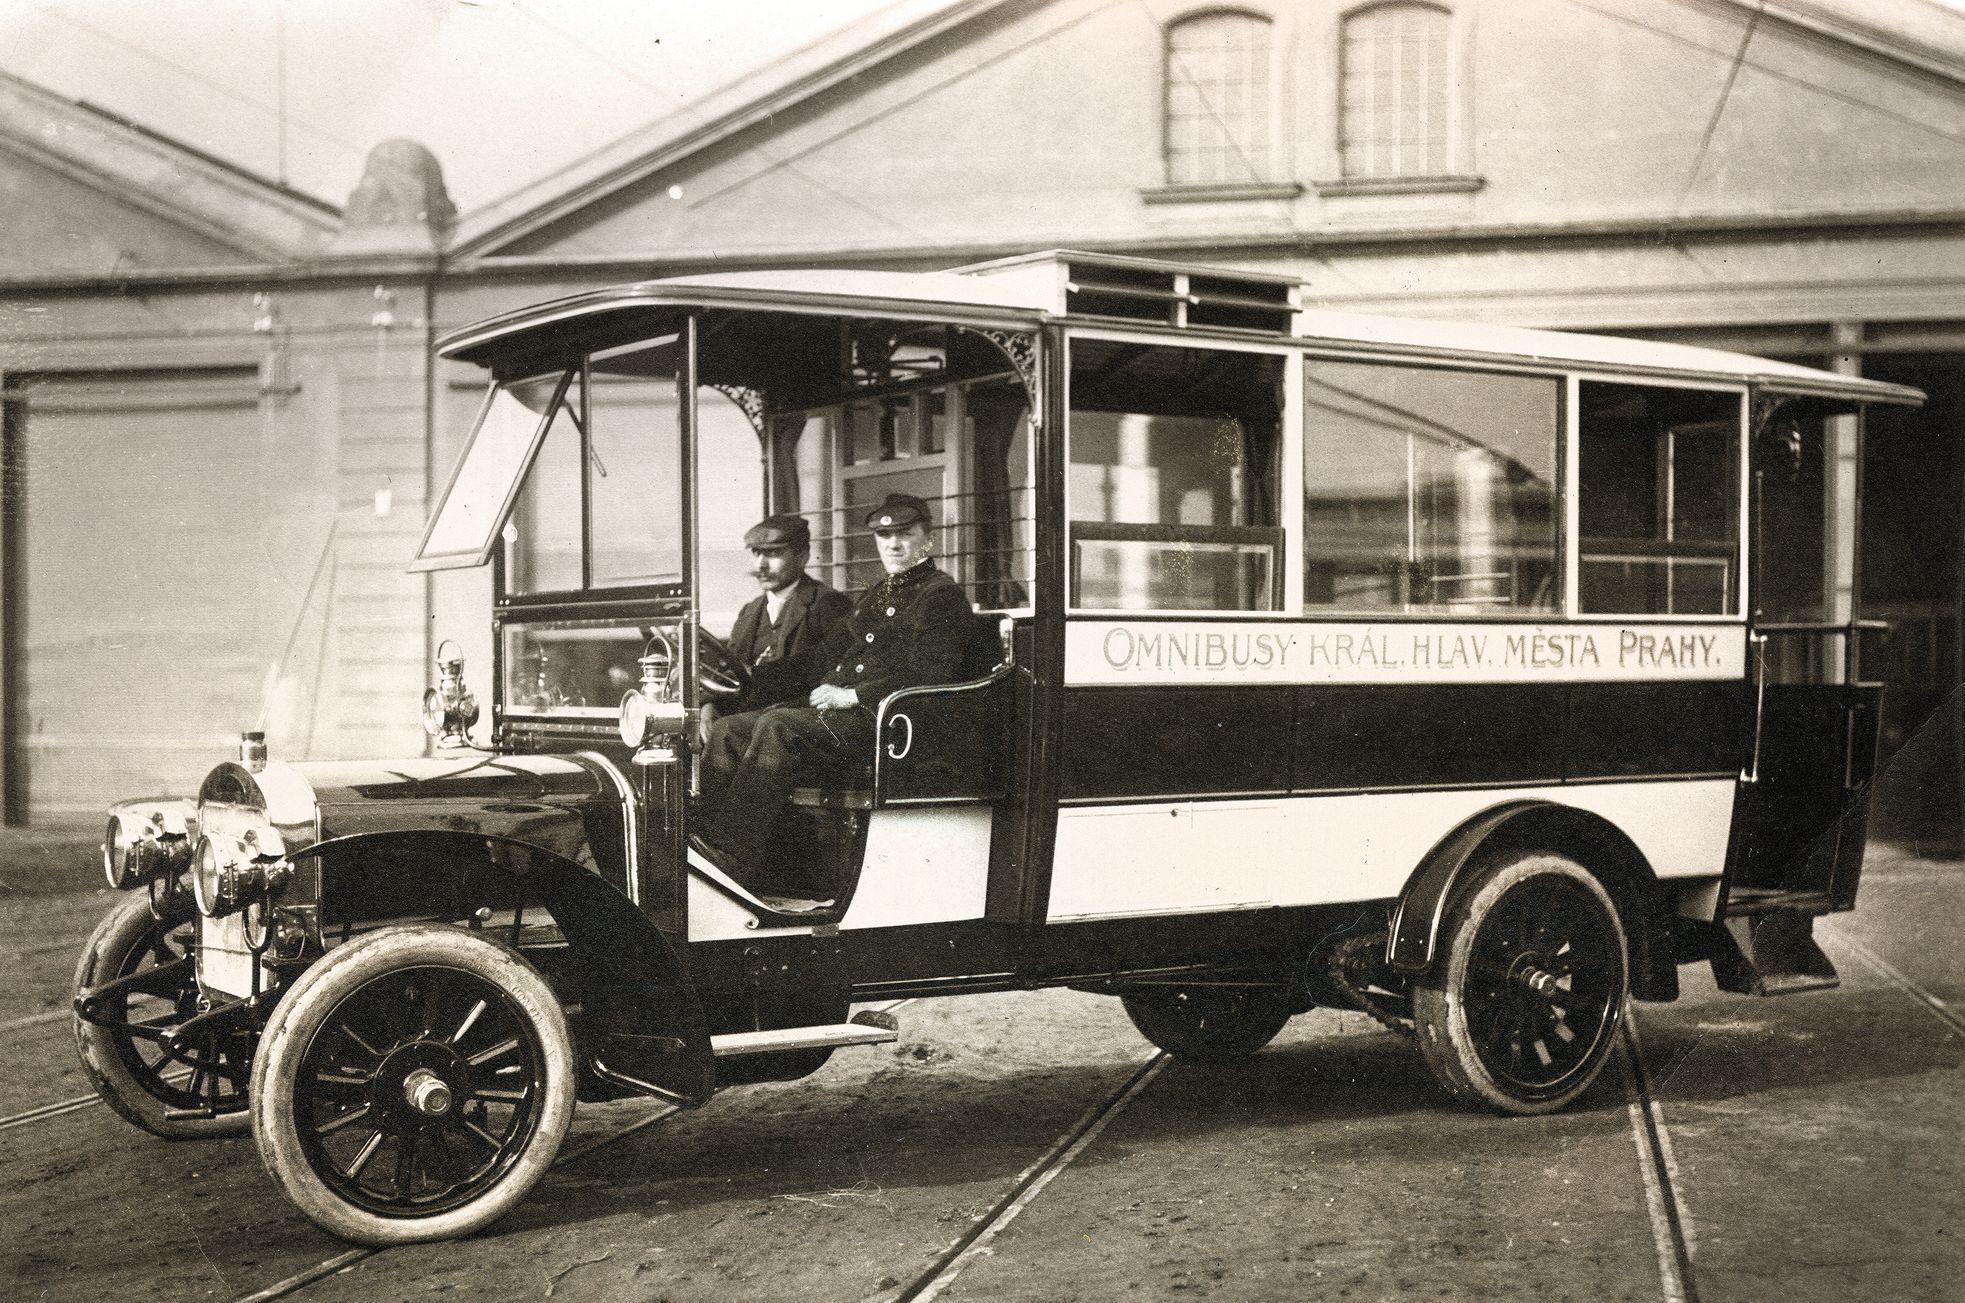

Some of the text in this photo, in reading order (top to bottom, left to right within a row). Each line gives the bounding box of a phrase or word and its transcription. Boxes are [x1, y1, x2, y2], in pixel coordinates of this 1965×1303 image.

[1103, 626, 1721, 669] OMNIBUSY KRÁL. HLAV. MĚSTA PRAHY.
